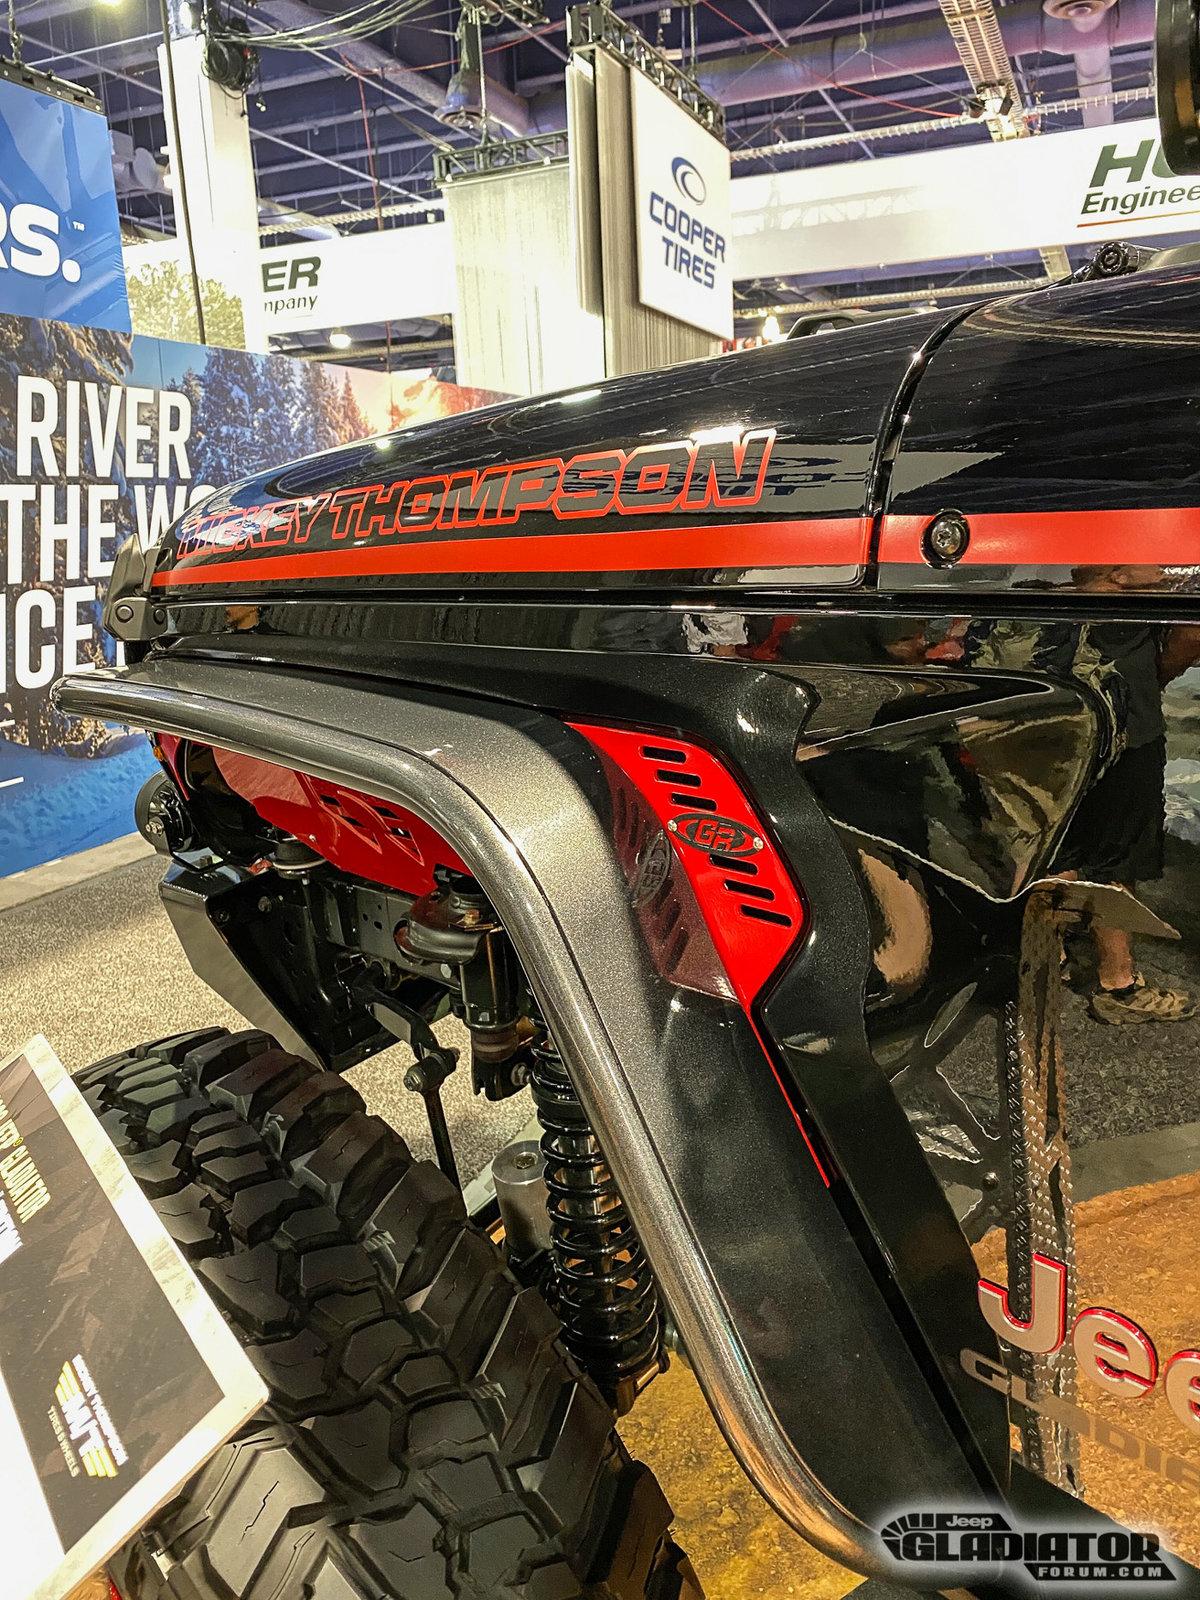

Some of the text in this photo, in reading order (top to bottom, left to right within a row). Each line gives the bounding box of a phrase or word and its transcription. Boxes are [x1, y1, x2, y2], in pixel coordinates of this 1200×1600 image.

[649, 190, 726, 263] COOPER
[662, 235, 716, 290] TIRES
[17, 375, 192, 479] RIVER
[0, 484, 217, 585] THE W
[176, 427, 777, 560] MICKEY THOMPSON
[0, 1144, 51, 1224] GLADIATOR
